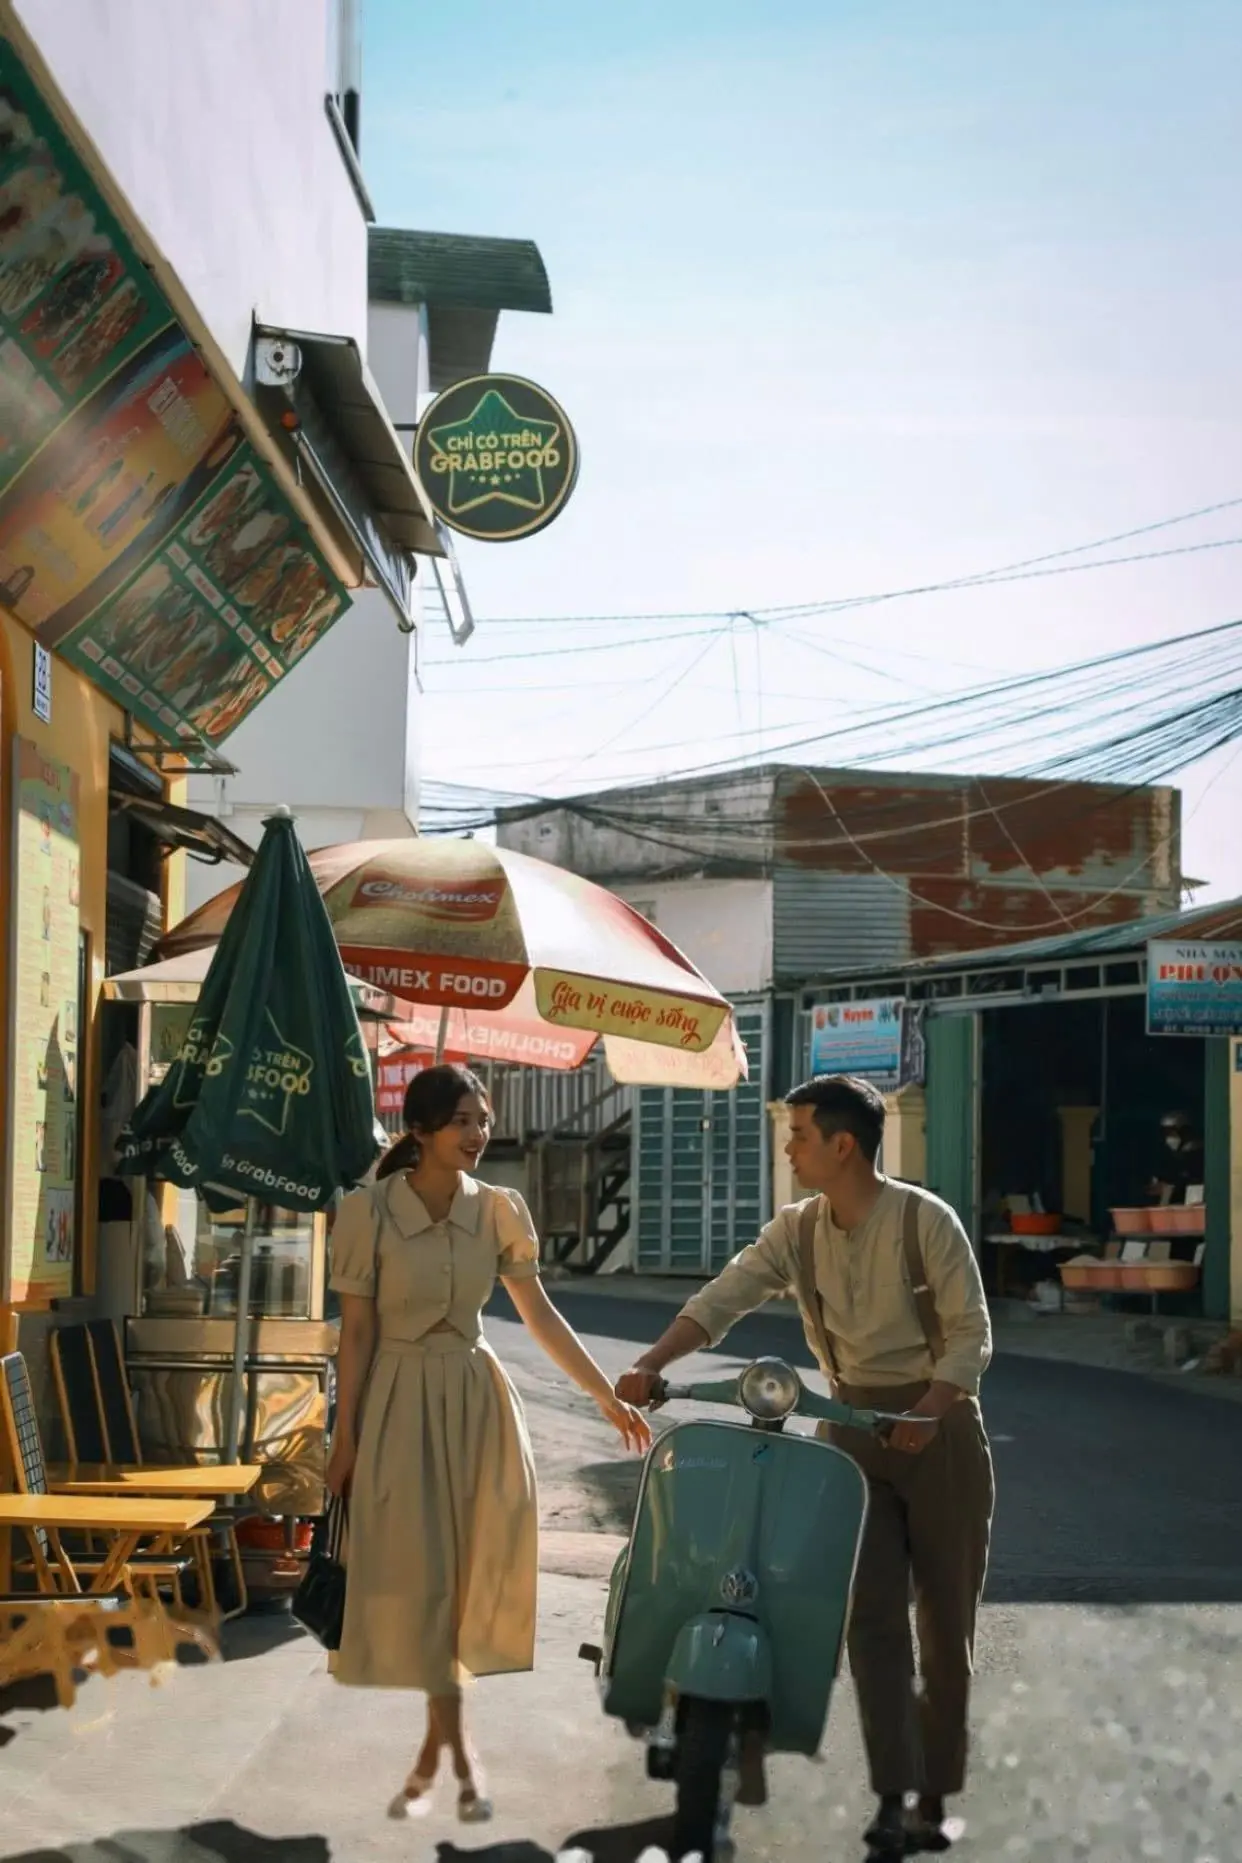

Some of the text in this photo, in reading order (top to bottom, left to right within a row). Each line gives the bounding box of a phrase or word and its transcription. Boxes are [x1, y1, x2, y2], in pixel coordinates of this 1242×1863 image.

[447, 429, 542, 451] CHỈ CÓ TRÊN
[430, 448, 560, 473] GRABFOOD
[361, 880, 496, 904] Cholimex
[439, 973, 507, 998] FOOD
[549, 980, 582, 1018] Gia
[587, 993, 608, 1019] vị
[611, 999, 652, 1025] cuộc
[236, 1159, 321, 1200] GrabFood
